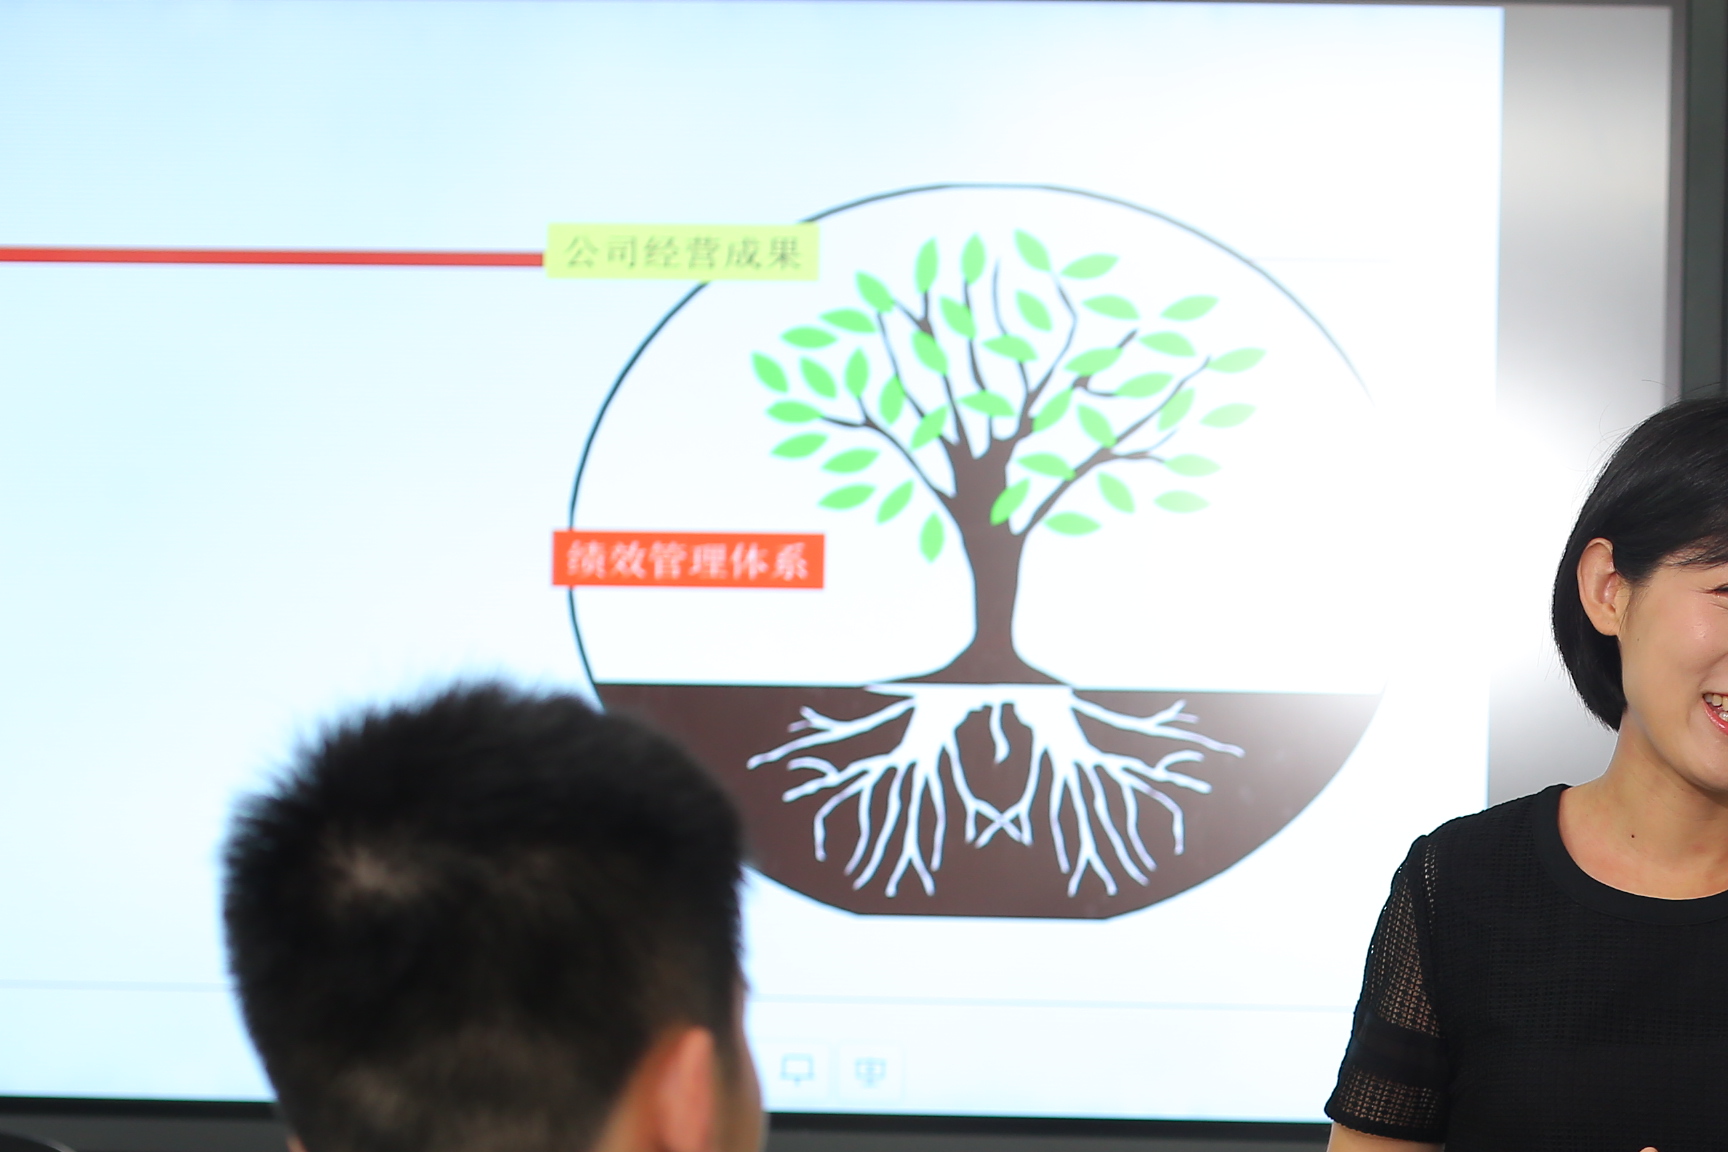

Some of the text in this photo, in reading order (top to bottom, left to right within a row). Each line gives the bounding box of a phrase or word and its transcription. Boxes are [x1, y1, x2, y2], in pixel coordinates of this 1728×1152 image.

[565, 235, 803, 270] 公司经营成果
[566, 540, 808, 581] 绩效管理体系
